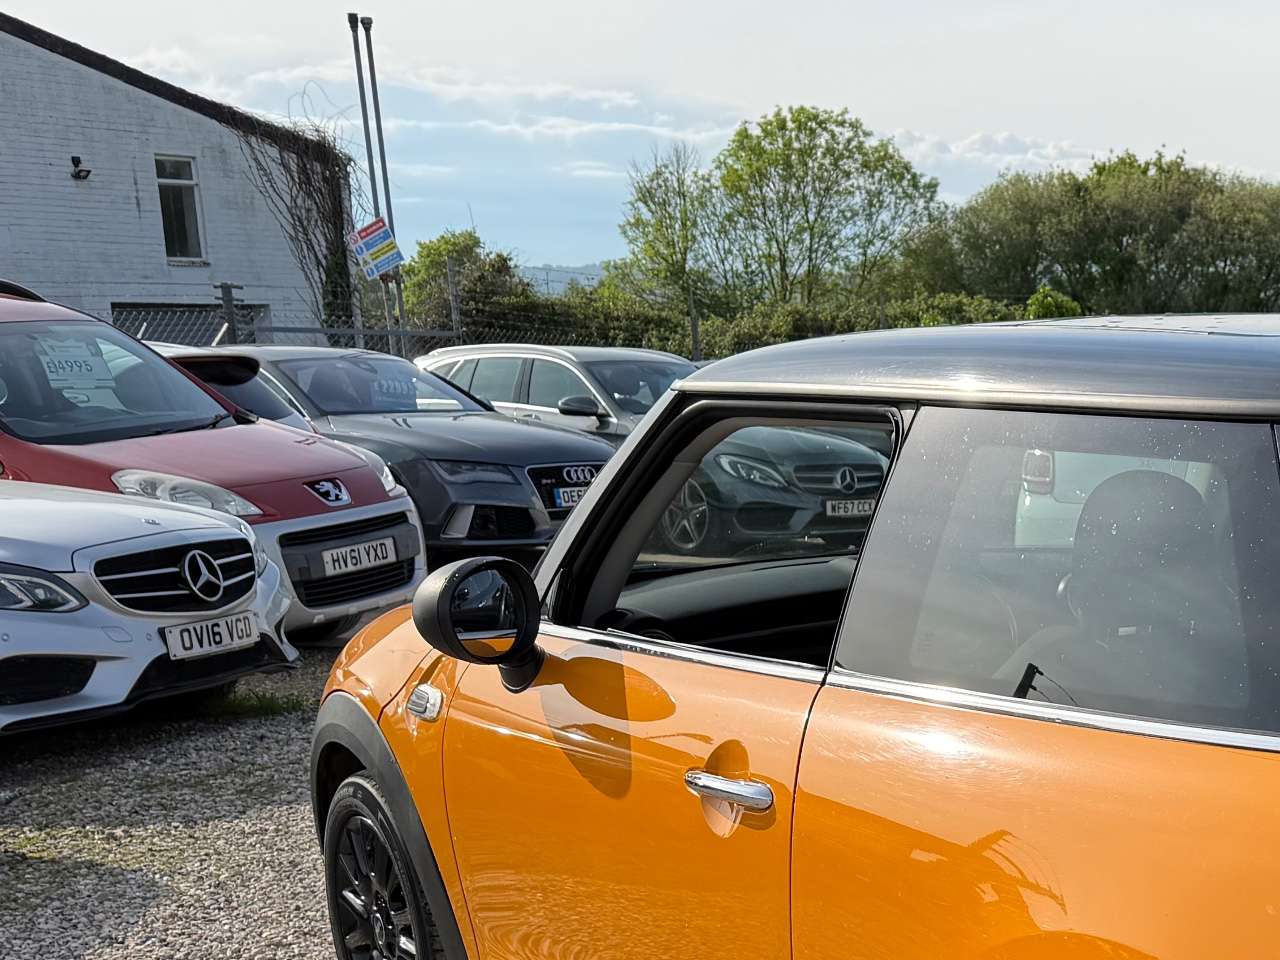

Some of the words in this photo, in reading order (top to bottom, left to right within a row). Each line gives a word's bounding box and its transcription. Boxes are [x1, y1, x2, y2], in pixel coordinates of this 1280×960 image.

[831, 501, 855, 514] WF67
[331, 547, 362, 571] HV61
[364, 542, 388, 563] YXD
[180, 622, 223, 651] OV16
[225, 616, 252, 642] VGD
